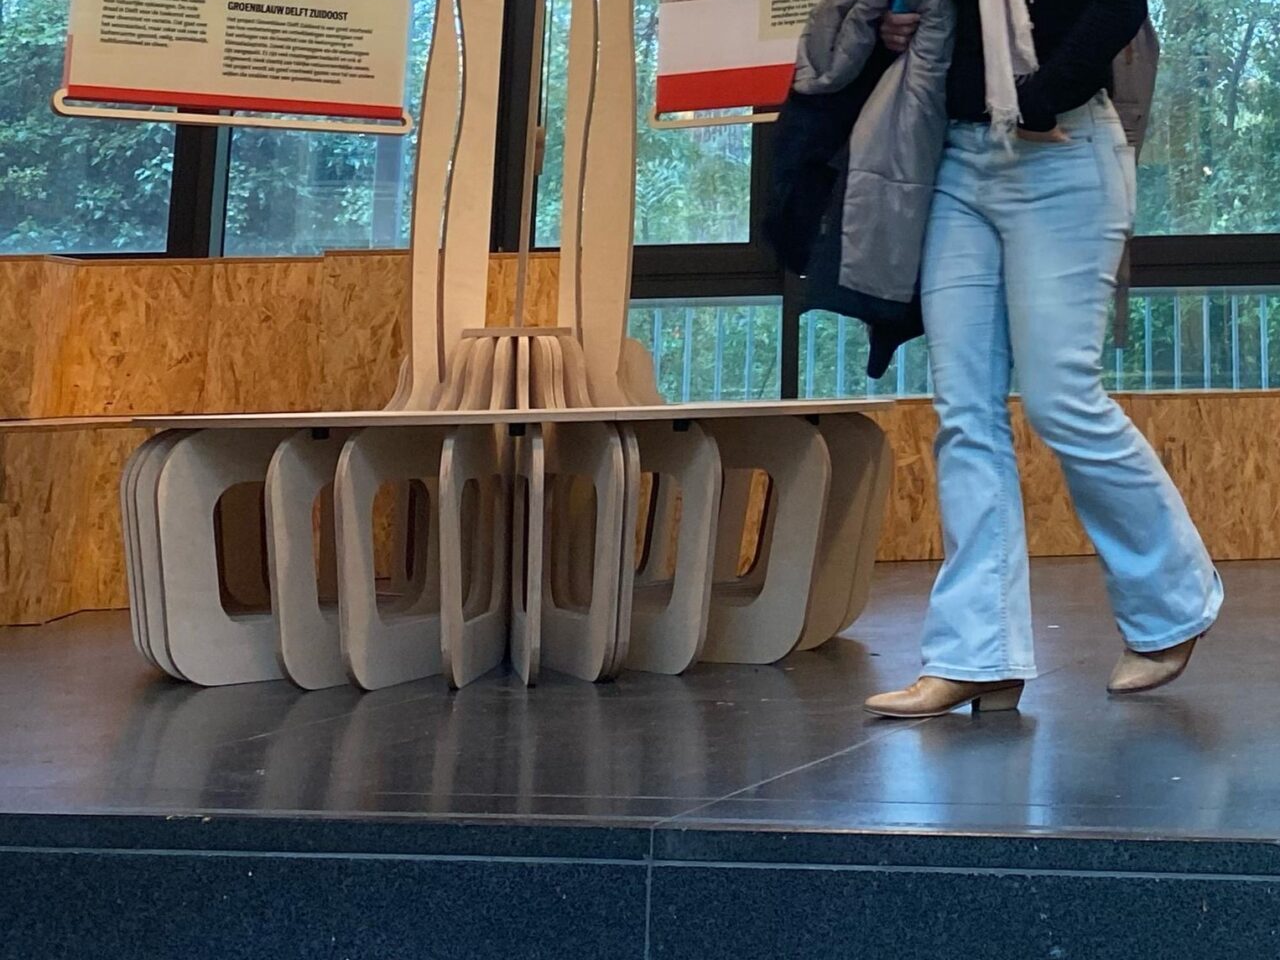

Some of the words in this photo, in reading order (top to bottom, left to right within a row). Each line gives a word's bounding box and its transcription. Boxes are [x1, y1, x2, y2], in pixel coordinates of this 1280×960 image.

[228, 2, 284, 15] GROENBLAUW
[285, 6, 308, 17] DELFT
[308, 8, 348, 21] ZUIDOOST
